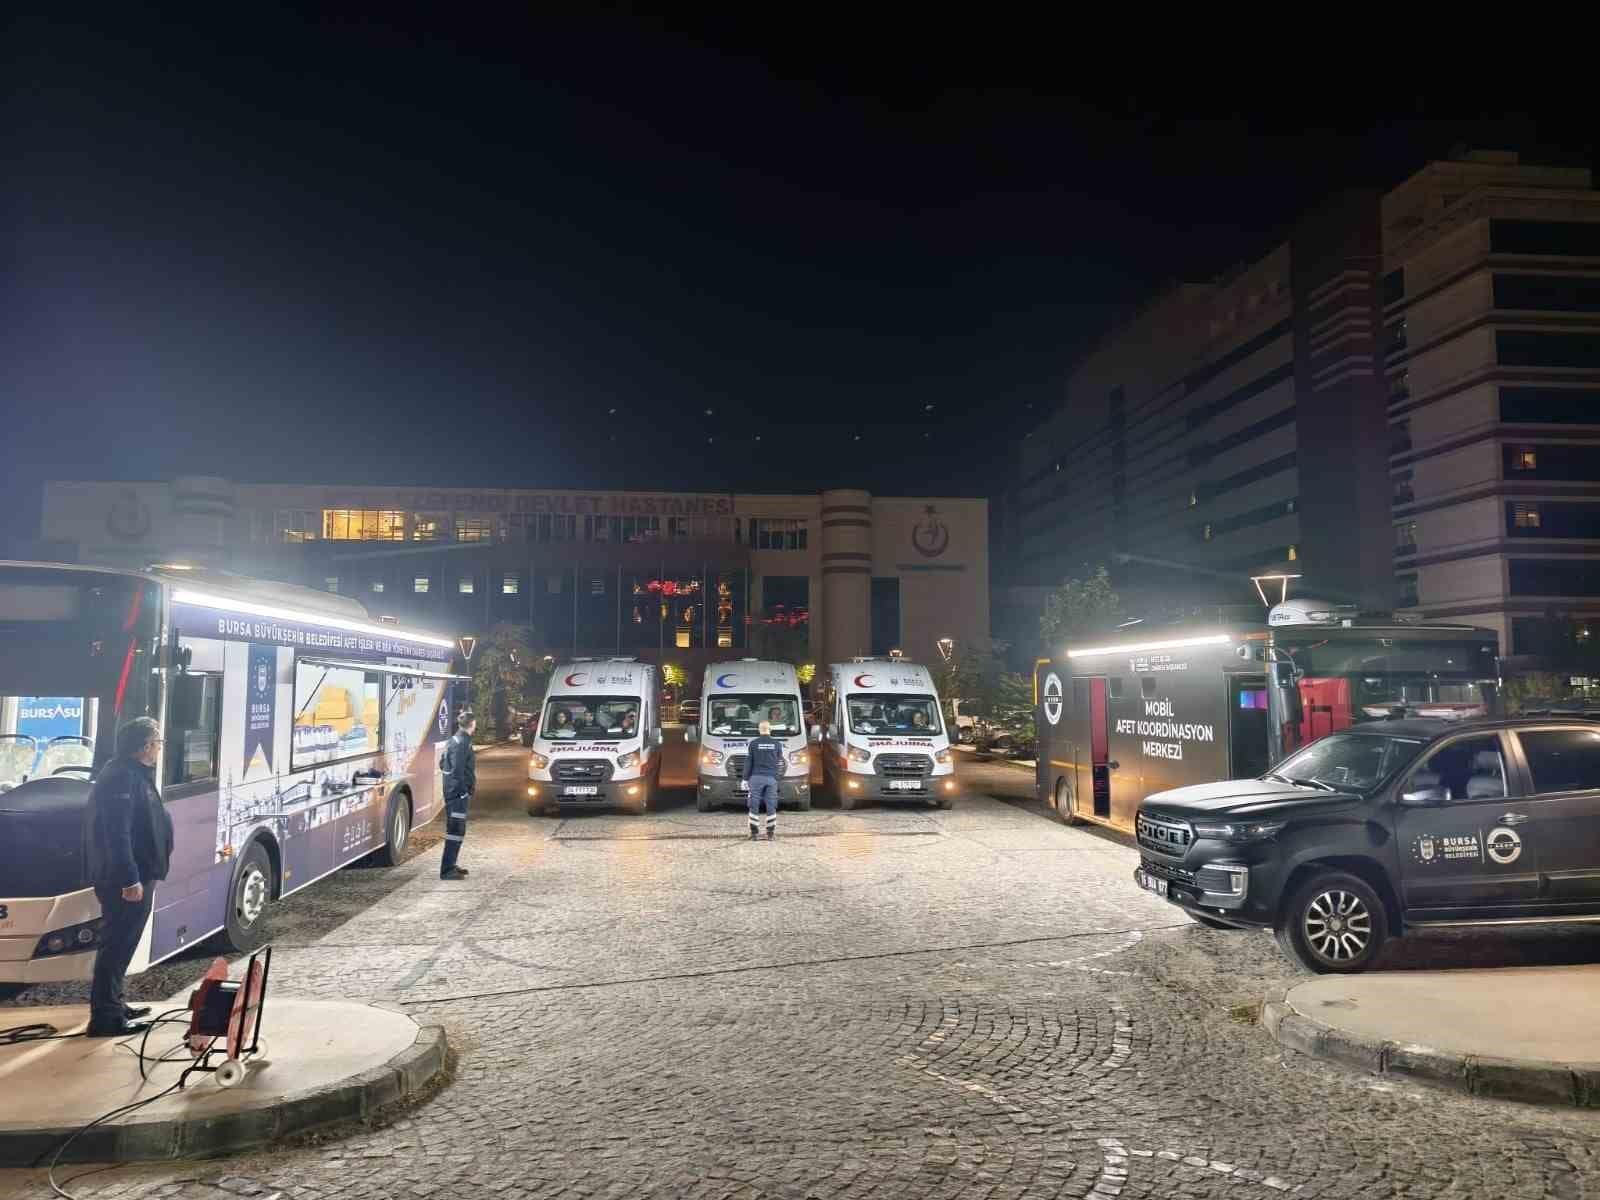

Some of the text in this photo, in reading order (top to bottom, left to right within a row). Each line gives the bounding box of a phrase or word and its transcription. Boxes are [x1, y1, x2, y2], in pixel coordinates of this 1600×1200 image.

[218, 619, 252, 637] BURSA
[1145, 697, 1174, 717] MOBİL
[1116, 719, 1213, 742] AFET KOORDİNASYON
[1143, 740, 1182, 760] MERKEZİ
[1443, 837, 1478, 846] BURSA
